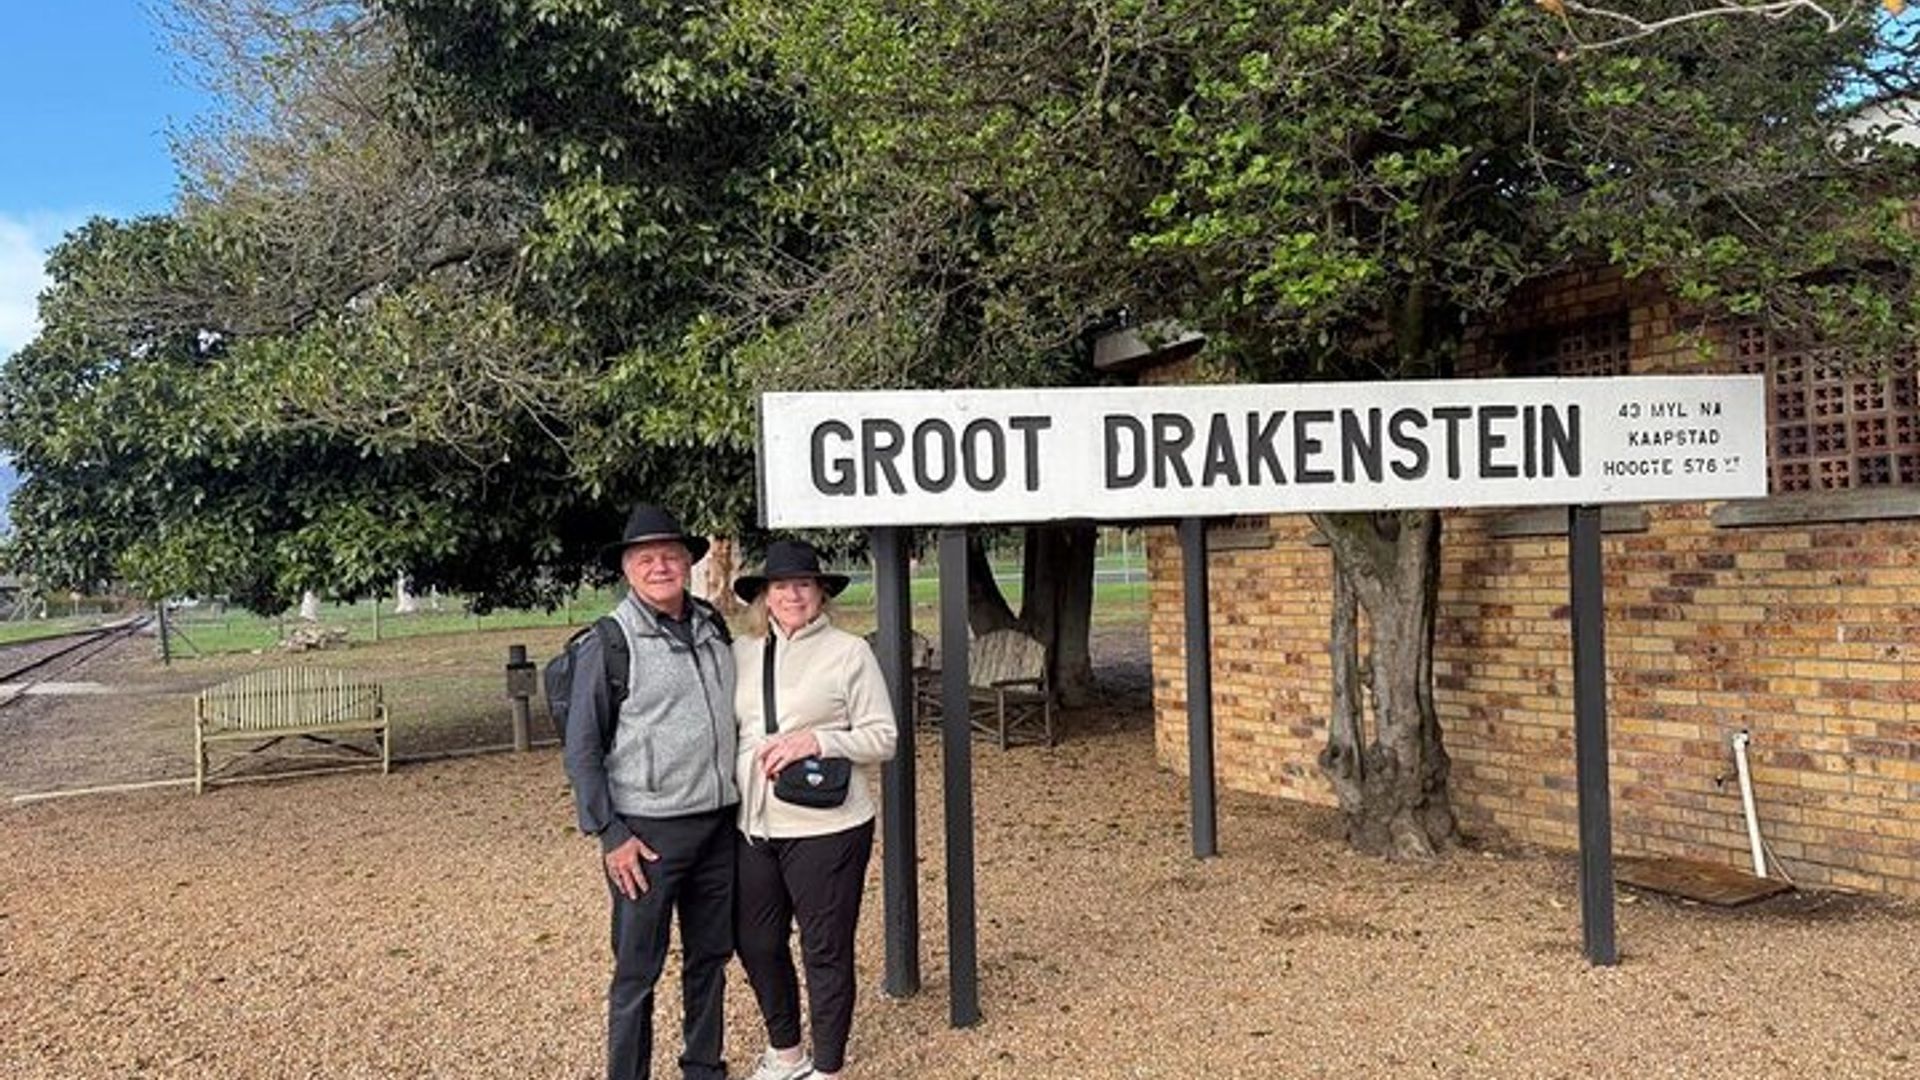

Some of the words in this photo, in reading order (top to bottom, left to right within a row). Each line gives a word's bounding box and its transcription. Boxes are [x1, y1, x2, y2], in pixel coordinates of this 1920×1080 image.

[1618, 402, 1641, 418] 43
[1650, 402, 1687, 418] MYL
[1700, 402, 1722, 415] NA
[1628, 429, 1720, 446] KAAPSTAD
[810, 414, 1052, 496] GROOT
[1104, 403, 1582, 489] DRAKENSTEIN
[1603, 459, 1673, 475] HOOGTE
[1683, 458, 1718, 473] 576
